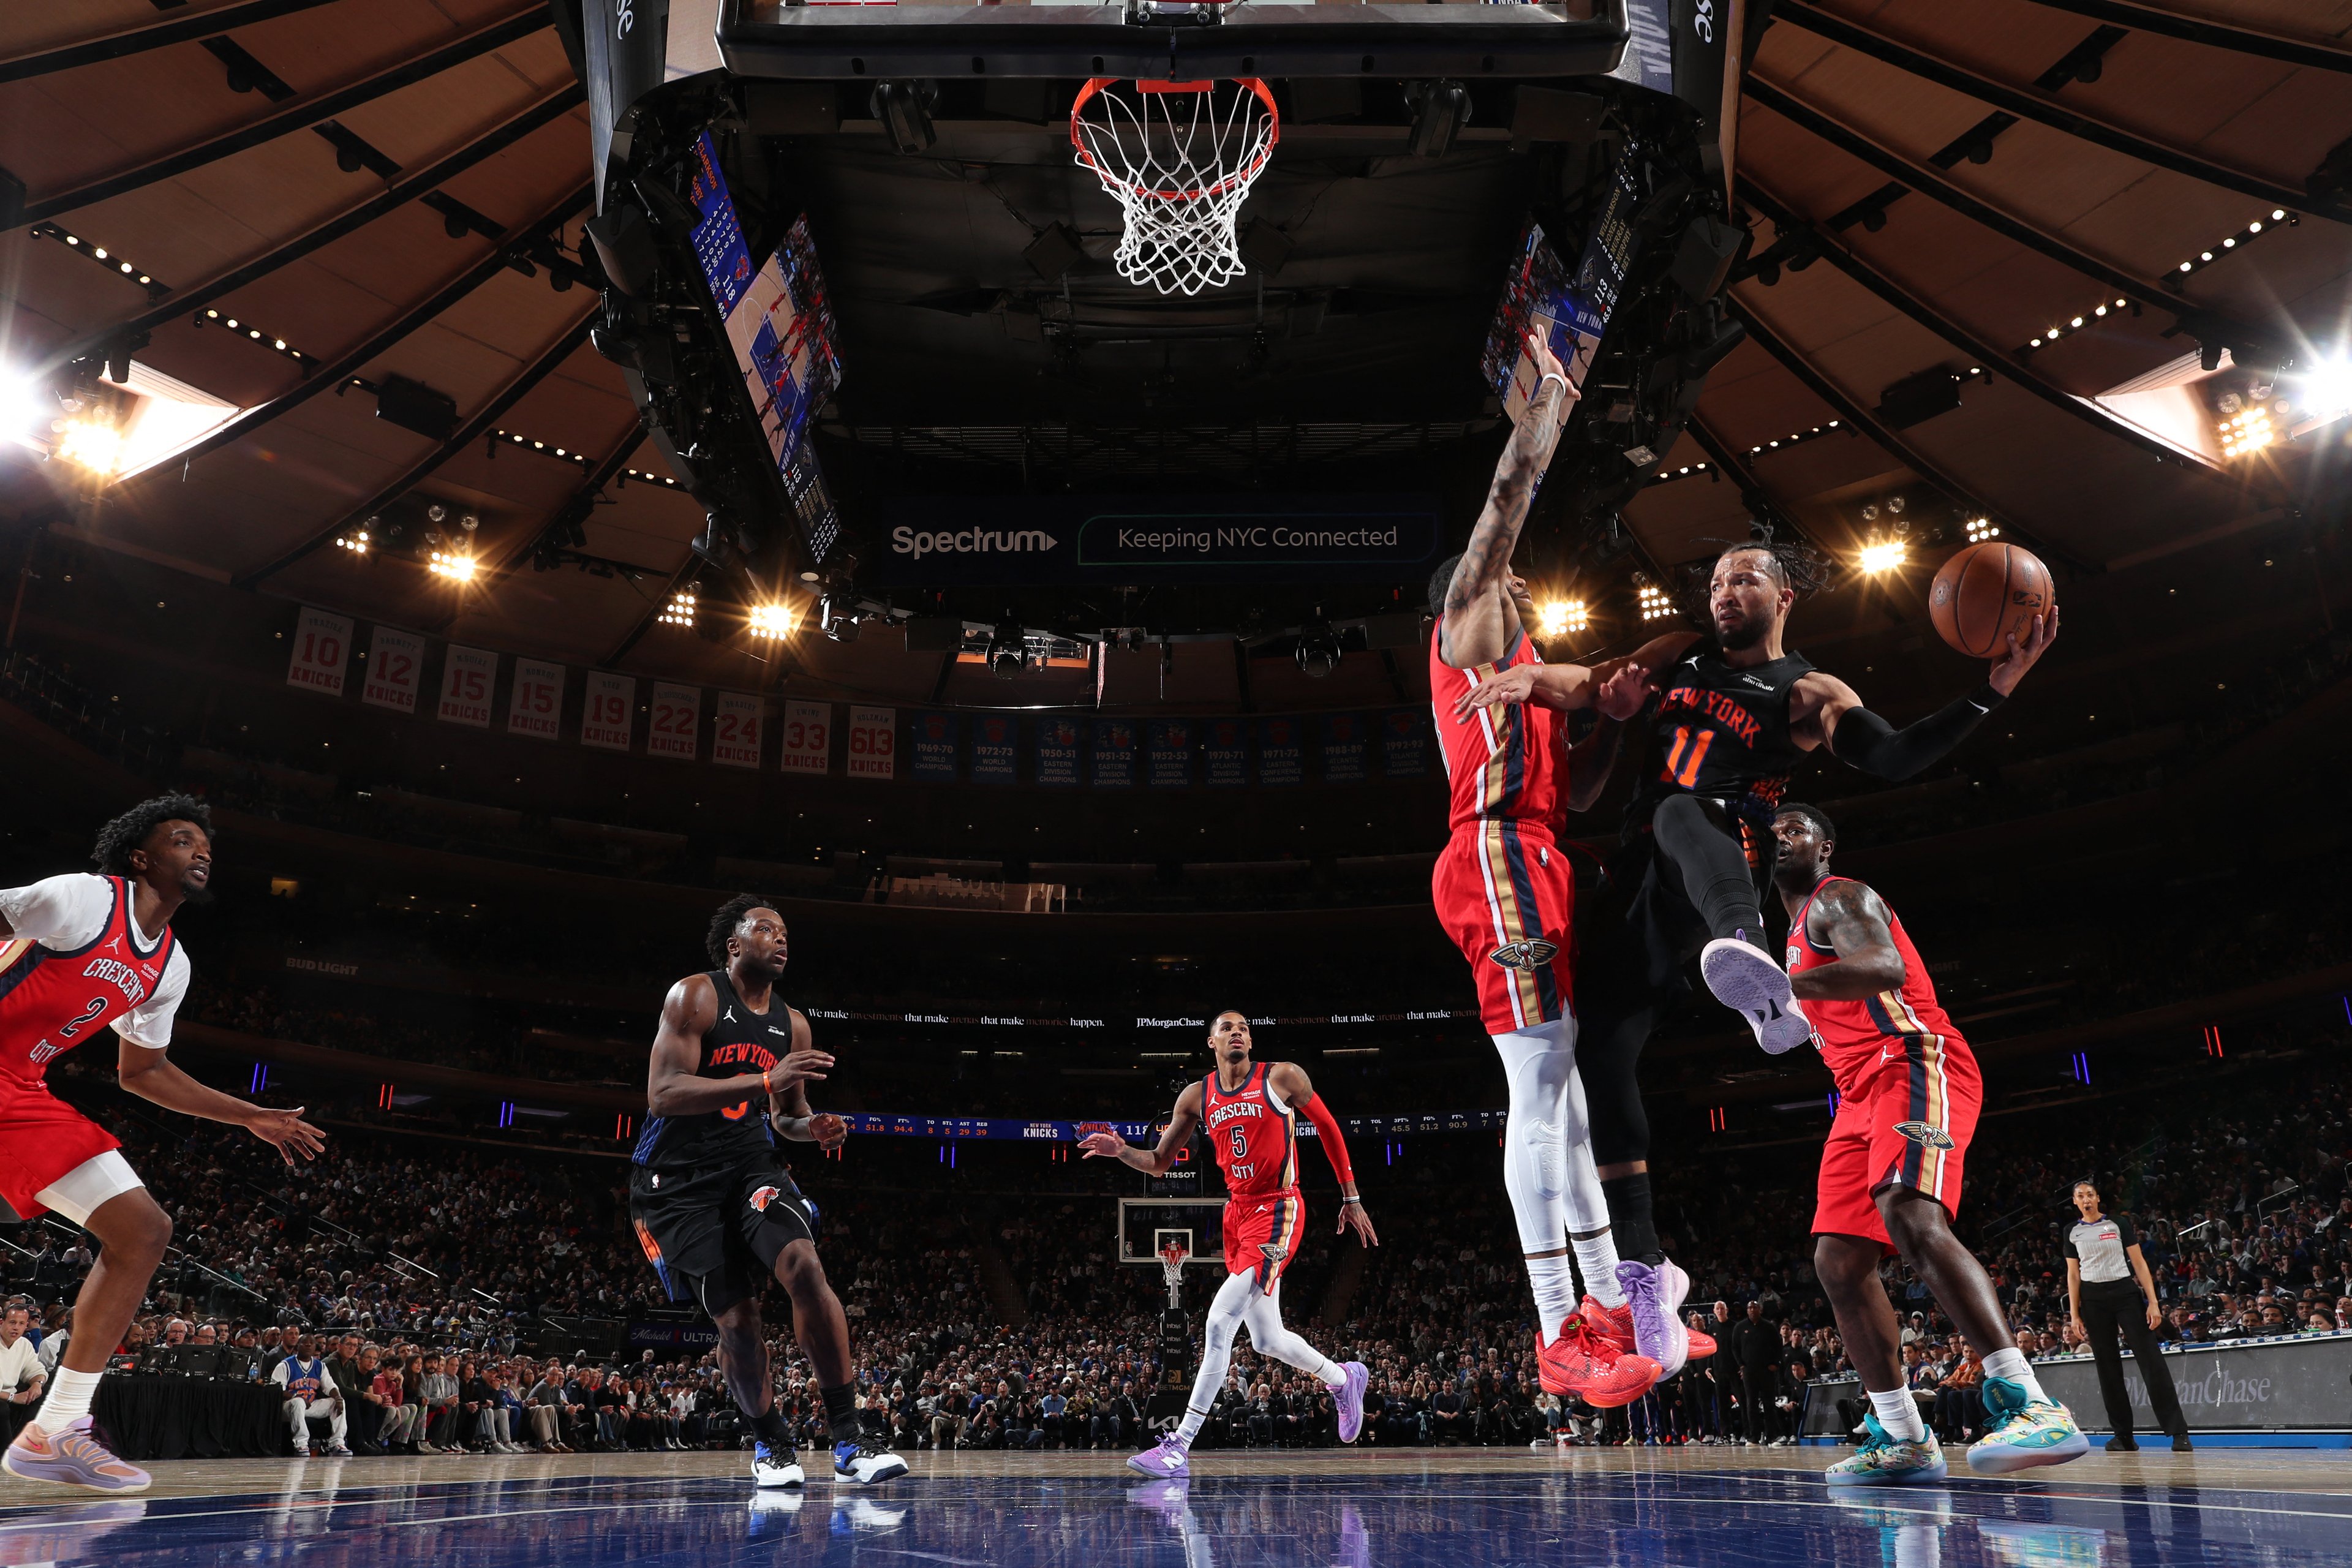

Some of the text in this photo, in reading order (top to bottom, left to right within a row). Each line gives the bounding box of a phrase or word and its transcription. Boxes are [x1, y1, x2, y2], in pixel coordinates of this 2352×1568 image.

[698, 142, 718, 190] CLARKSON
[1599, 186, 1621, 238] WILLIAMSON
[1605, 218, 1618, 246] JONES
[1610, 218, 1626, 255] MURRAY
[1611, 227, 1632, 274] 25 MURPHY
[1617, 252, 1630, 281] 41 BEY
[723, 274, 736, 301] 118
[1594, 278, 1608, 305] 113
[718, 301, 727, 320] 45.9
[1577, 311, 1588, 323] NEW
[1602, 306, 1612, 324] 45.9
[892, 526, 1397, 560] Spectrum Keeping NYC Connected
[309, 618, 343, 633] FRAZIER
[302, 633, 341, 667] 10
[291, 666, 341, 690] KNICKS
[375, 651, 412, 686] 12
[526, 668, 556, 680] MONROE
[450, 668, 486, 701] 15
[602, 680, 621, 690] REED
[366, 684, 413, 707] KNICKS
[520, 682, 555, 714] 15
[441, 702, 488, 722] KNICKS
[592, 694, 625, 725] 19
[725, 700, 756, 712] BRADLEY
[796, 708, 820, 718] EWING
[511, 715, 557, 734] KNICKS
[654, 704, 695, 736] 22
[856, 713, 889, 724] HOLZMAN
[1705, 690, 1762, 750] YORK
[584, 726, 628, 745] KNICKS
[719, 714, 758, 744] 24
[787, 722, 827, 751] 33
[650, 737, 694, 754] KNICKS
[850, 727, 894, 755] 613
[917, 743, 953, 754] 1969-70
[1386, 740, 1423, 750] 1992-93
[716, 745, 758, 763] KNICKS
[977, 746, 1013, 756] 1972-73
[1041, 748, 1076, 758] 1950-51
[1096, 751, 1131, 761] 1951-52
[1152, 752, 1188, 760] 1952-53
[1208, 751, 1244, 760] 1970-71
[1263, 748, 1298, 758] 1971-72
[1659, 723, 1717, 791] 11
[784, 754, 826, 769] KNICKS
[850, 759, 891, 774] KNICKS
[140, 969, 154, 981] PRODUCTS
[142, 962, 160, 978] NEWAGE
[286, 957, 359, 975] BUD LIGHT
[82, 958, 146, 1008] CRESCENT
[59, 996, 109, 1038] 2
[809, 1008, 1105, 1028] We make investments that make arenas that make memories happen.
[1136, 1017, 1205, 1028] JPMorganChase
[1252, 1009, 1451, 1025] make investments that make arenas that make
[29, 1038, 64, 1064] CITY
[1209, 1102, 1264, 1129] CRESCENT
[894, 1125, 914, 1134] 94.4
[927, 1126, 933, 1135] 8
[1023, 1127, 1058, 1138] KNICKS
[1230, 1125, 1247, 1158] 5
[1231, 1163, 1254, 1180] CITY
[630, 1327, 720, 1343] Michelob ULTRA
